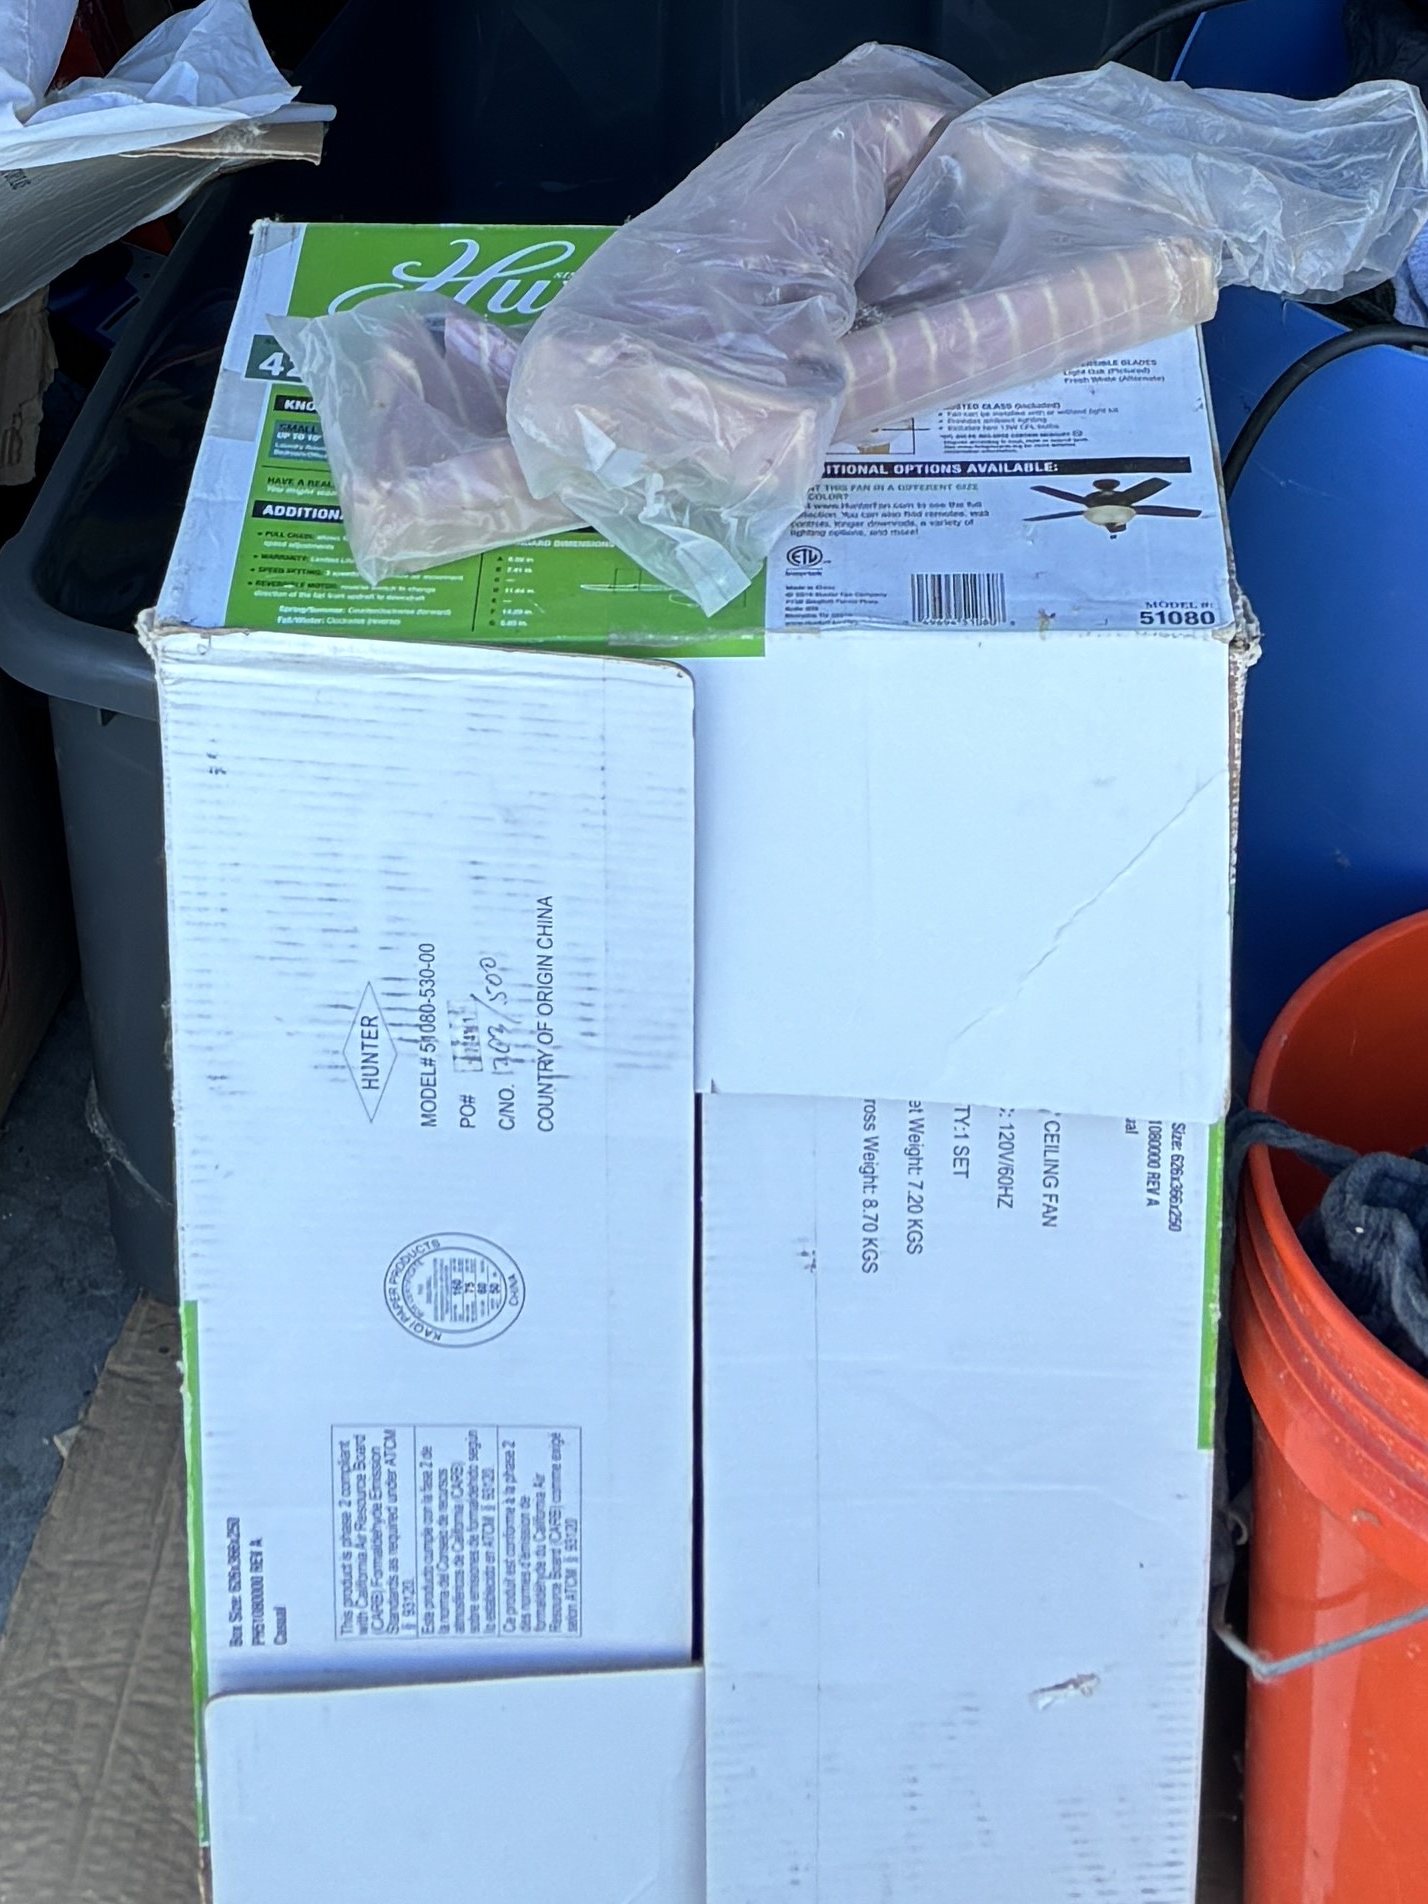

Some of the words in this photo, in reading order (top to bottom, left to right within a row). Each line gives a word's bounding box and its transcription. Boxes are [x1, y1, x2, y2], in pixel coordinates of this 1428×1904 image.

[284, 400, 316, 411] KNO
[822, 463, 888, 476] ITIONAL
[893, 463, 962, 475] OPTIONS
[966, 462, 1059, 474] AVAILABLE:
[262, 505, 343, 520] ADDITION
[1140, 609, 1217, 627] 51080
[536, 895, 553, 950] CHINA
[418, 943, 436, 1053] 51080-530-00
[536, 954, 554, 1016] ORIGIN
[537, 1020, 554, 1045] OF
[360, 1014, 379, 1090] HUNTER
[419, 1057, 437, 1128] MODEL#
[498, 1084, 515, 1131] C/NO.
[537, 1049, 554, 1132] COUNTRY
[908, 1100, 924, 1113] et
[460, 1094, 476, 1129] PO#
[862, 1098, 877, 1132] ross
[906, 1118, 925, 1176] Weight:
[953, 1145, 969, 1179] SET
[1042, 1120, 1061, 1189] CEILING
[860, 1136, 879, 1195] Weight:
[996, 1124, 1015, 1209] 120V/60HZ
[906, 1179, 923, 1214] 7.20
[1145, 1172, 1162, 1196] REV
[862, 1198, 879, 1233] 8.70
[1042, 1193, 1058, 1227] FAN
[1145, 1198, 1161, 1207] A
[906, 1218, 923, 1255] KGS
[861, 1237, 878, 1274] KGS
[508, 1273, 519, 1307] CHINA
